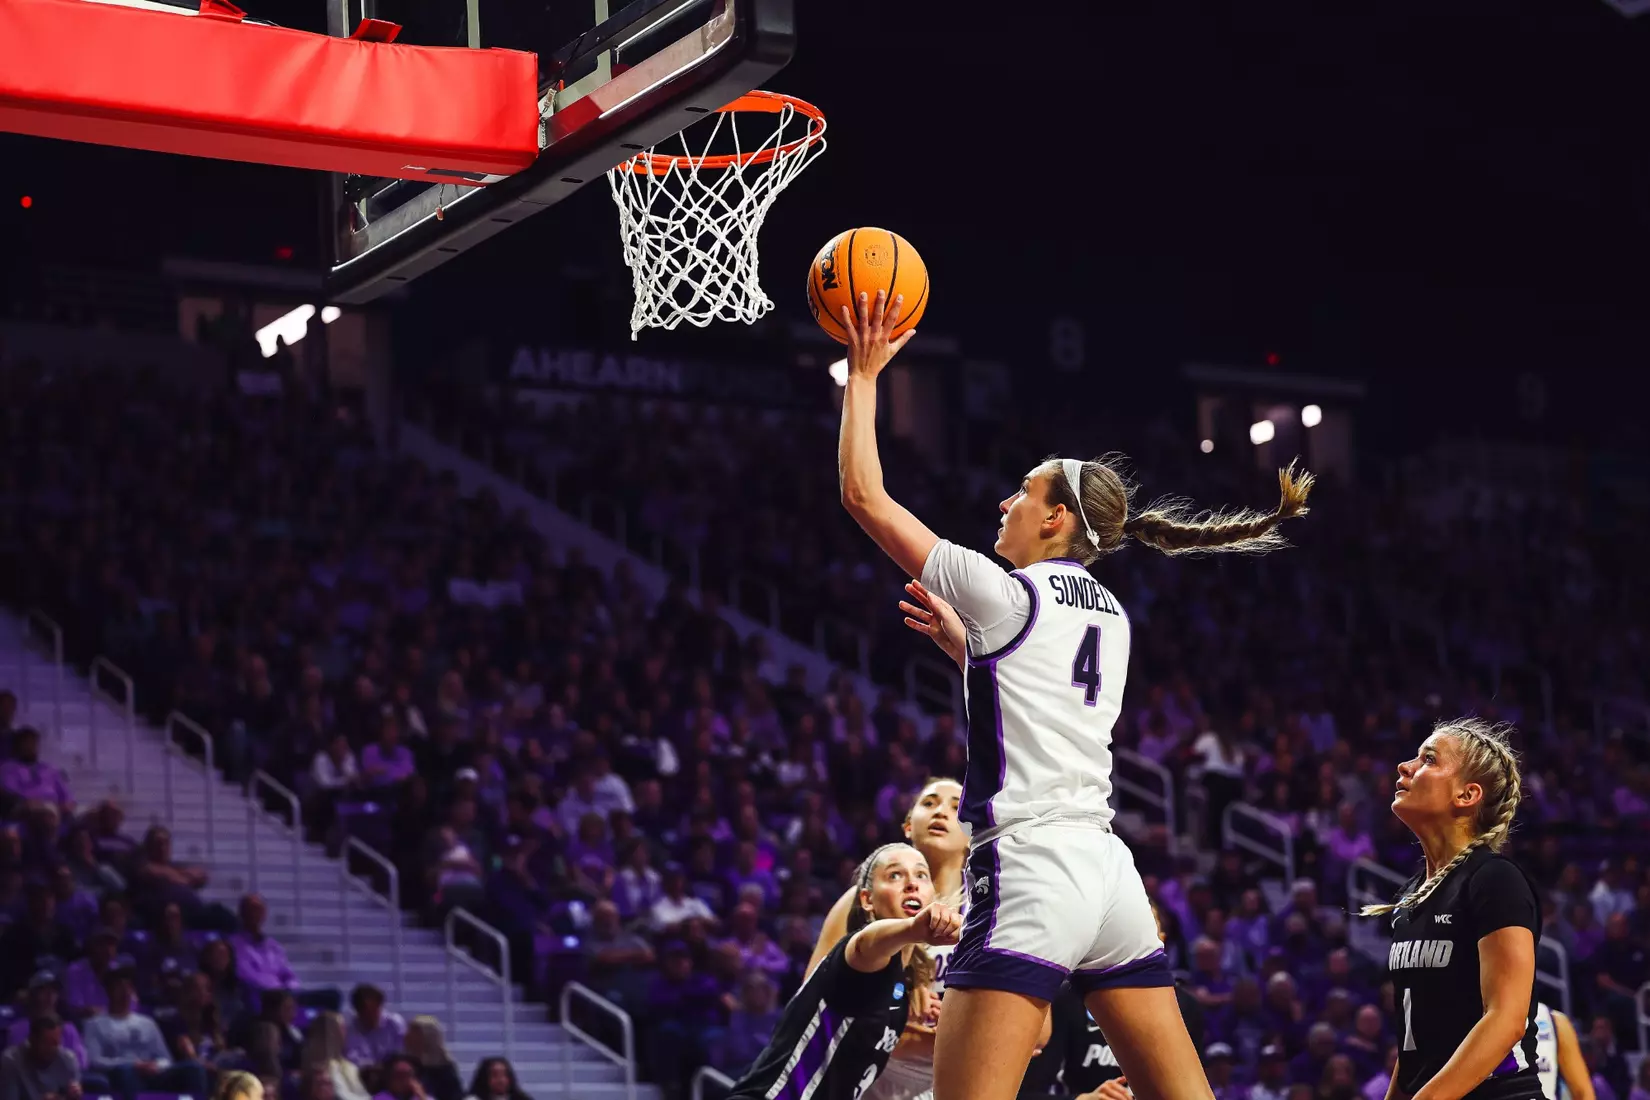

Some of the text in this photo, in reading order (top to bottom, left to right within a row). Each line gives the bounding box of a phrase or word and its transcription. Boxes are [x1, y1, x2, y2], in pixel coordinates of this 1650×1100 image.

[821, 244, 838, 291] NCA
[509, 347, 681, 390] AHEARN
[1049, 575, 1119, 616] SUNDELL
[1071, 624, 1101, 707] 4
[1434, 914, 1452, 924] WCC
[1388, 940, 1454, 971] ORTLAND
[1403, 988, 1417, 1051] 1
